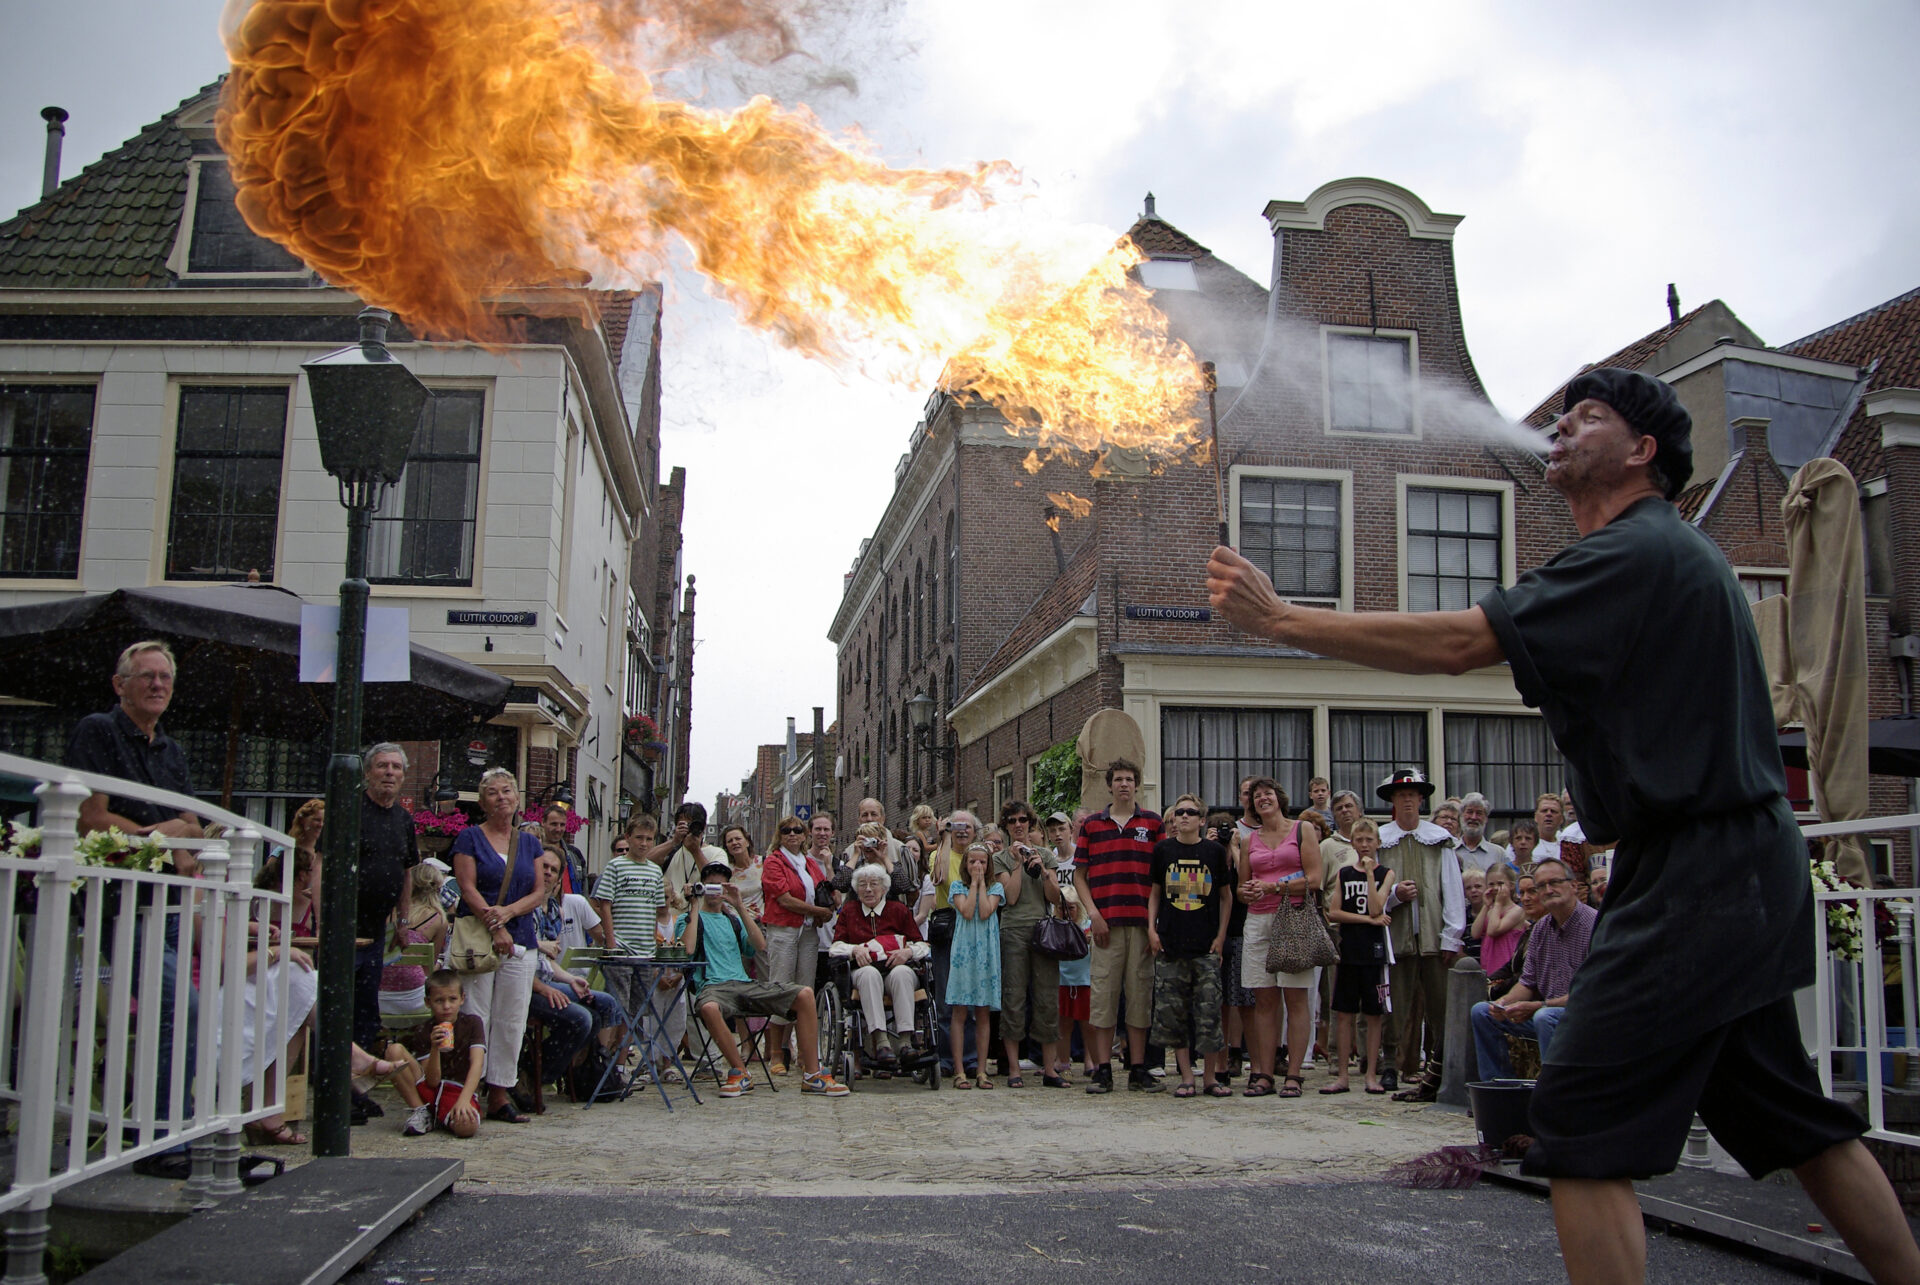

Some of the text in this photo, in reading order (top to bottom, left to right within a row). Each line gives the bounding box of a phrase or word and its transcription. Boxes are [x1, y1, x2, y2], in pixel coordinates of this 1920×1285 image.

[460, 613, 524, 623] LUTTIK OUDORP
[1136, 608, 1200, 619] LUTTIK OUDORP
[1356, 896, 1367, 914] 9
